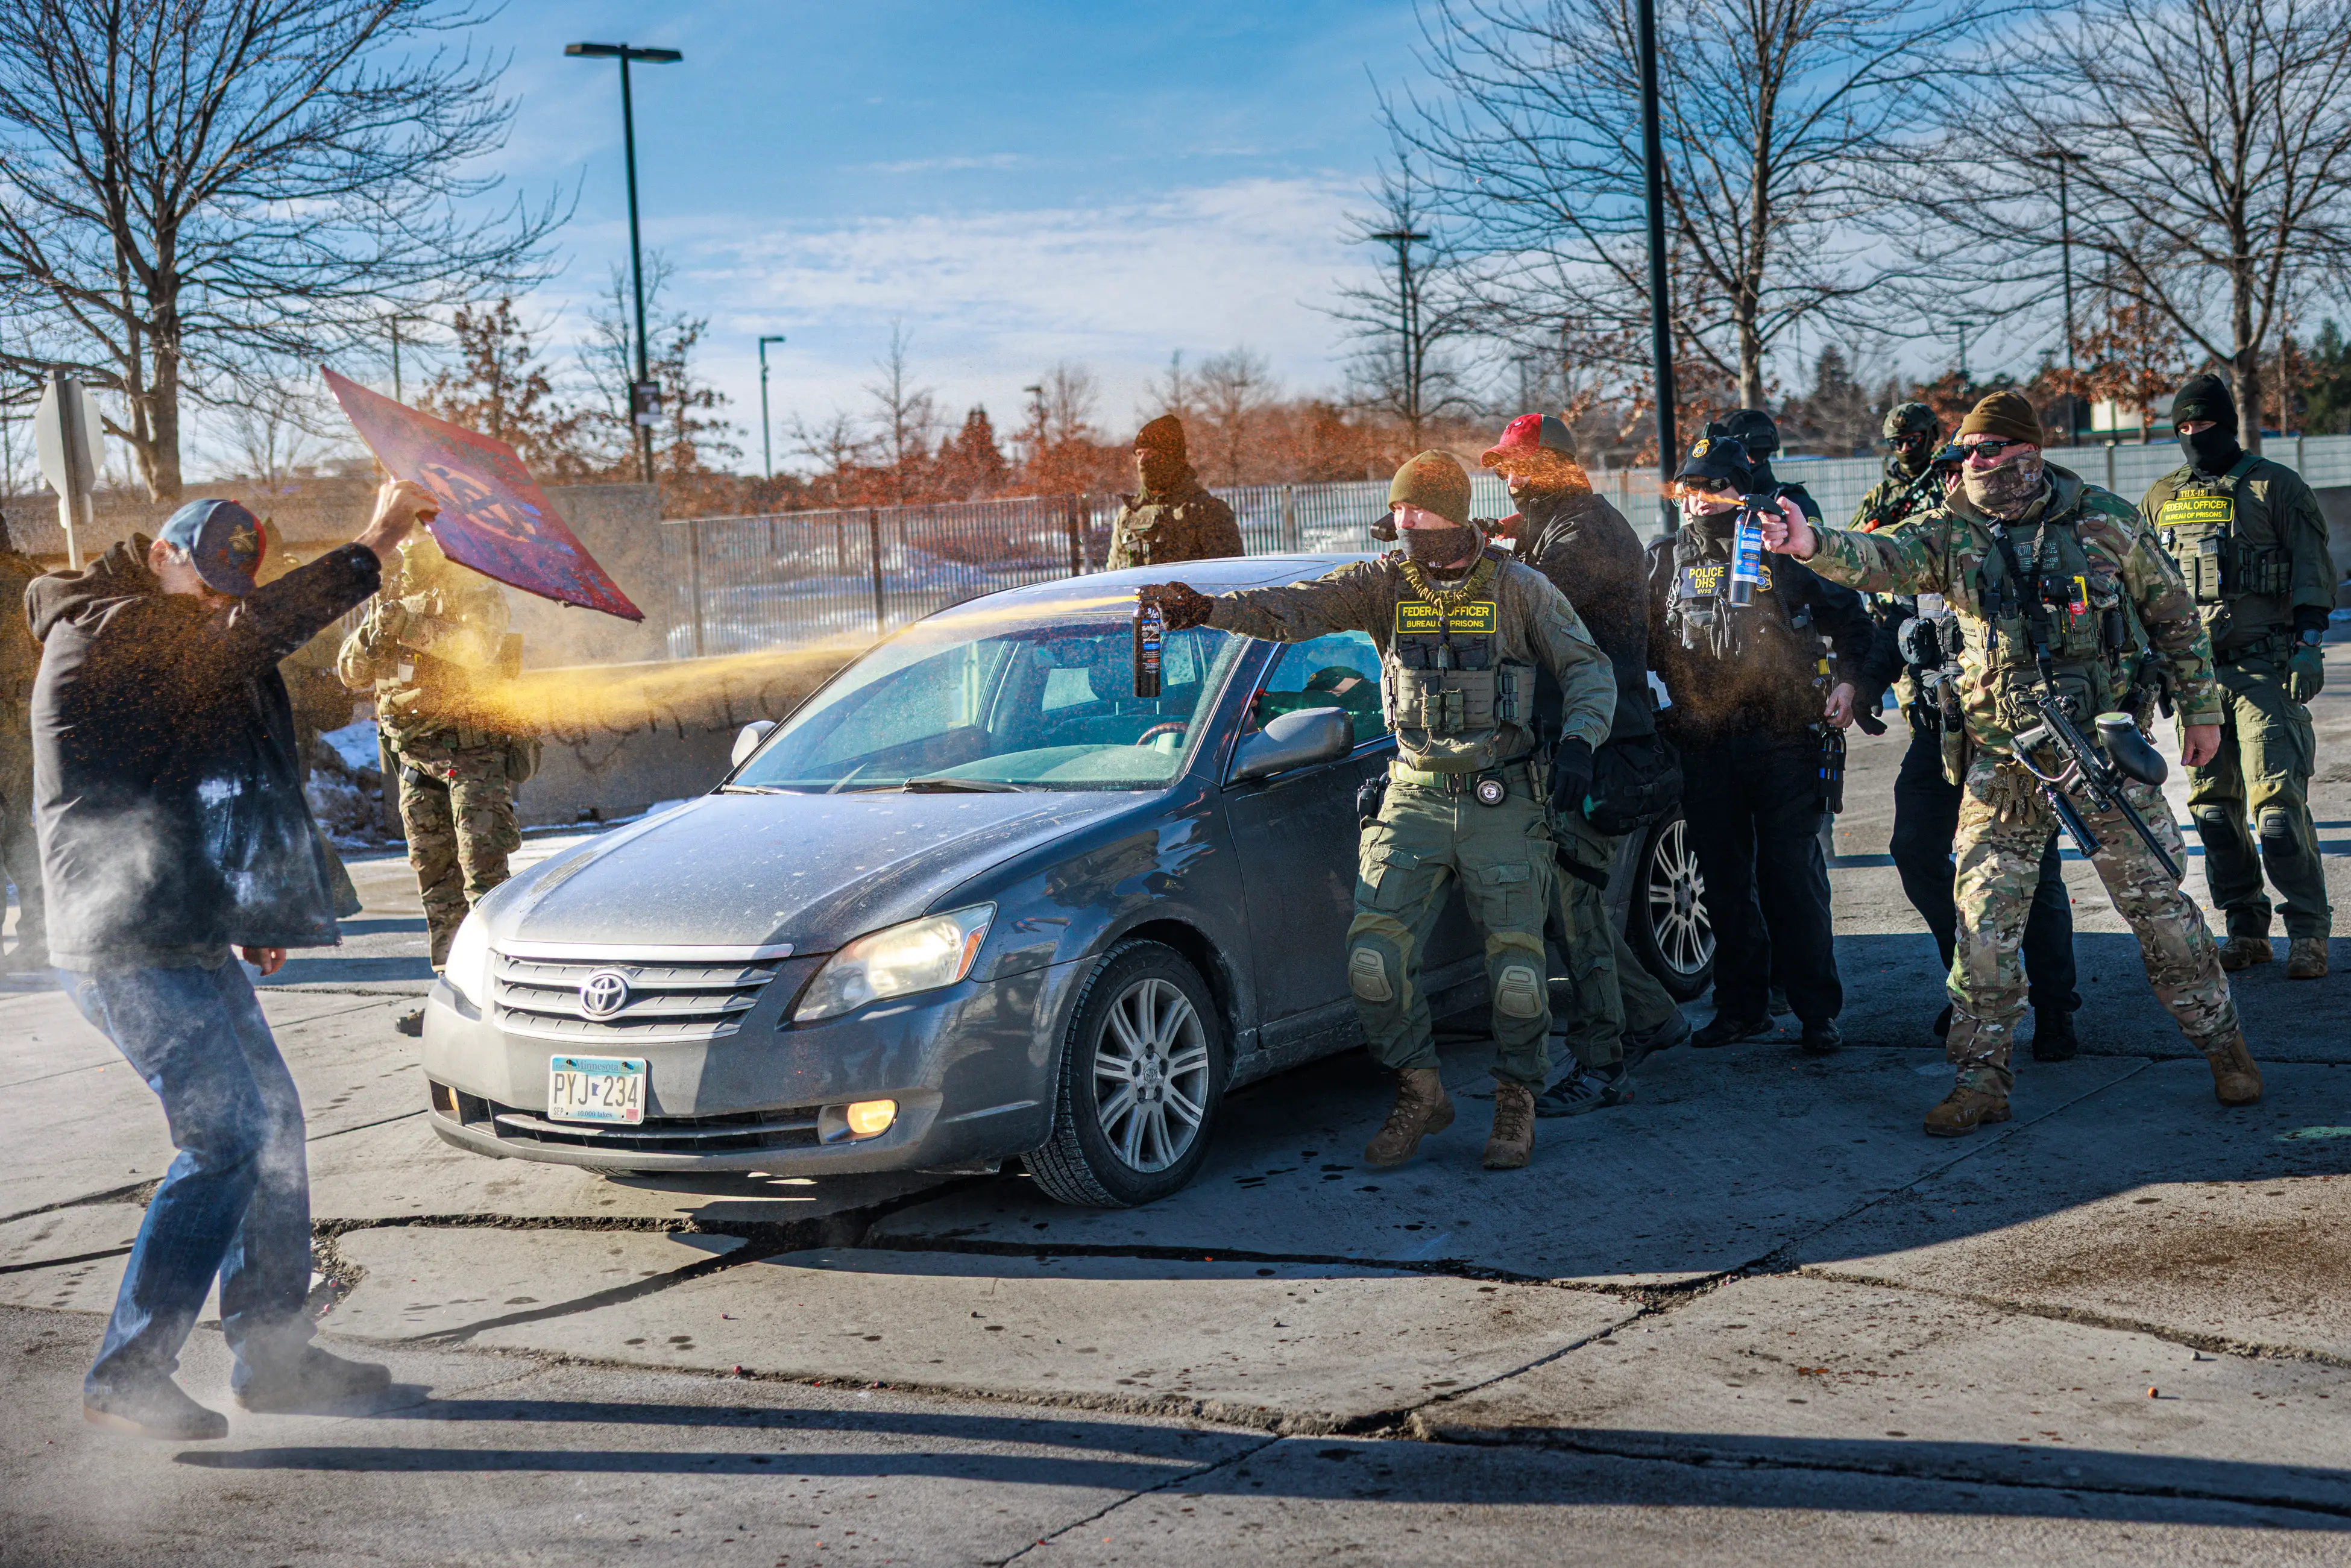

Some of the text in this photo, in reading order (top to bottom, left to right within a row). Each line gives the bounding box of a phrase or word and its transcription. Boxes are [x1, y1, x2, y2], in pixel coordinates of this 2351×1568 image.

[2180, 490, 2205, 498] THX-12
[2164, 500, 2228, 512] FEDERAL OFFICER
[2165, 512, 2186, 521] BUREAU
[2012, 542, 2057, 556] POLCE
[1689, 566, 1725, 579] POLICE
[1695, 577, 1716, 588] DHS
[1403, 606, 1443, 617] FEDERAL
[576, 1059, 619, 1071] Minnesota
[554, 1073, 638, 1107] PYJ 234
[553, 1107, 564, 1116] SEP
